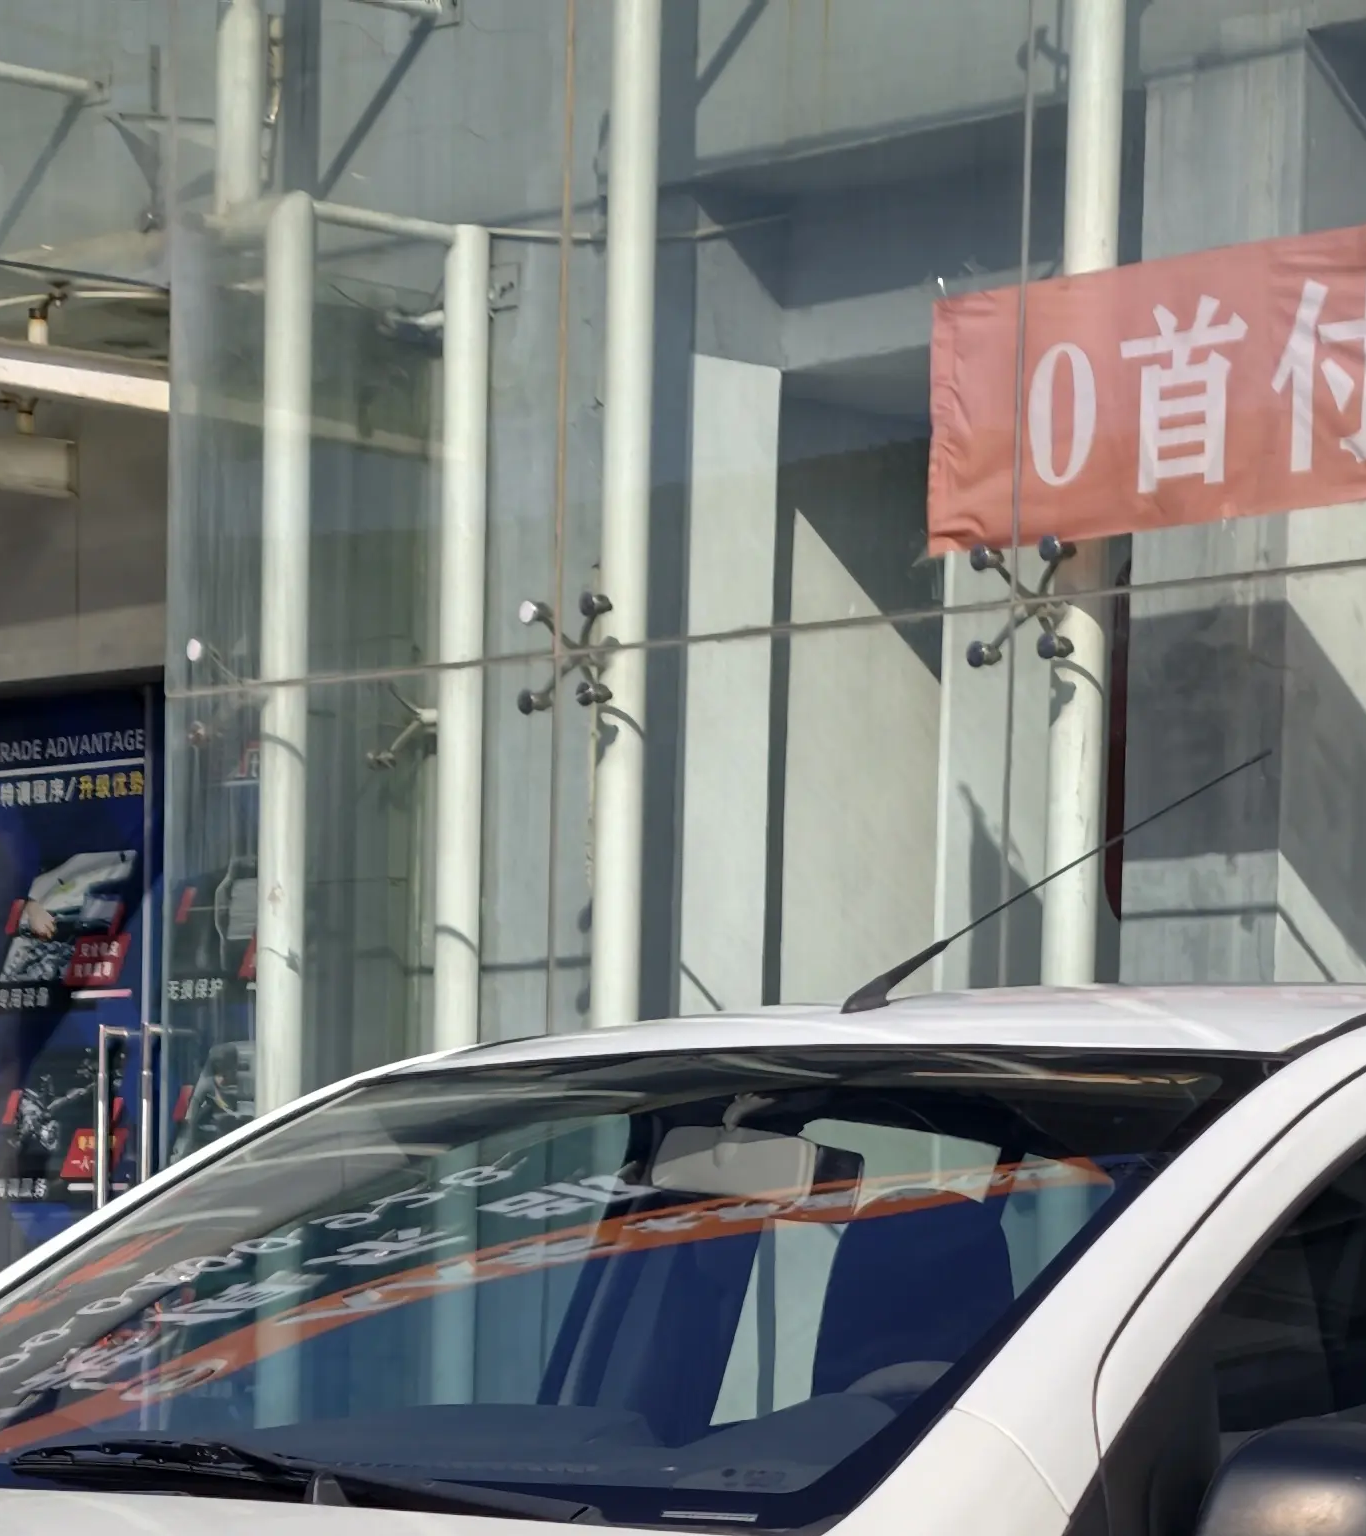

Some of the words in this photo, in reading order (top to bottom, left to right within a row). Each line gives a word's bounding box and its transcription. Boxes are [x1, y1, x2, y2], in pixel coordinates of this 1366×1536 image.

[45, 728, 145, 759] ADVANTAGE
[167, 977, 223, 1000] 无损保护
